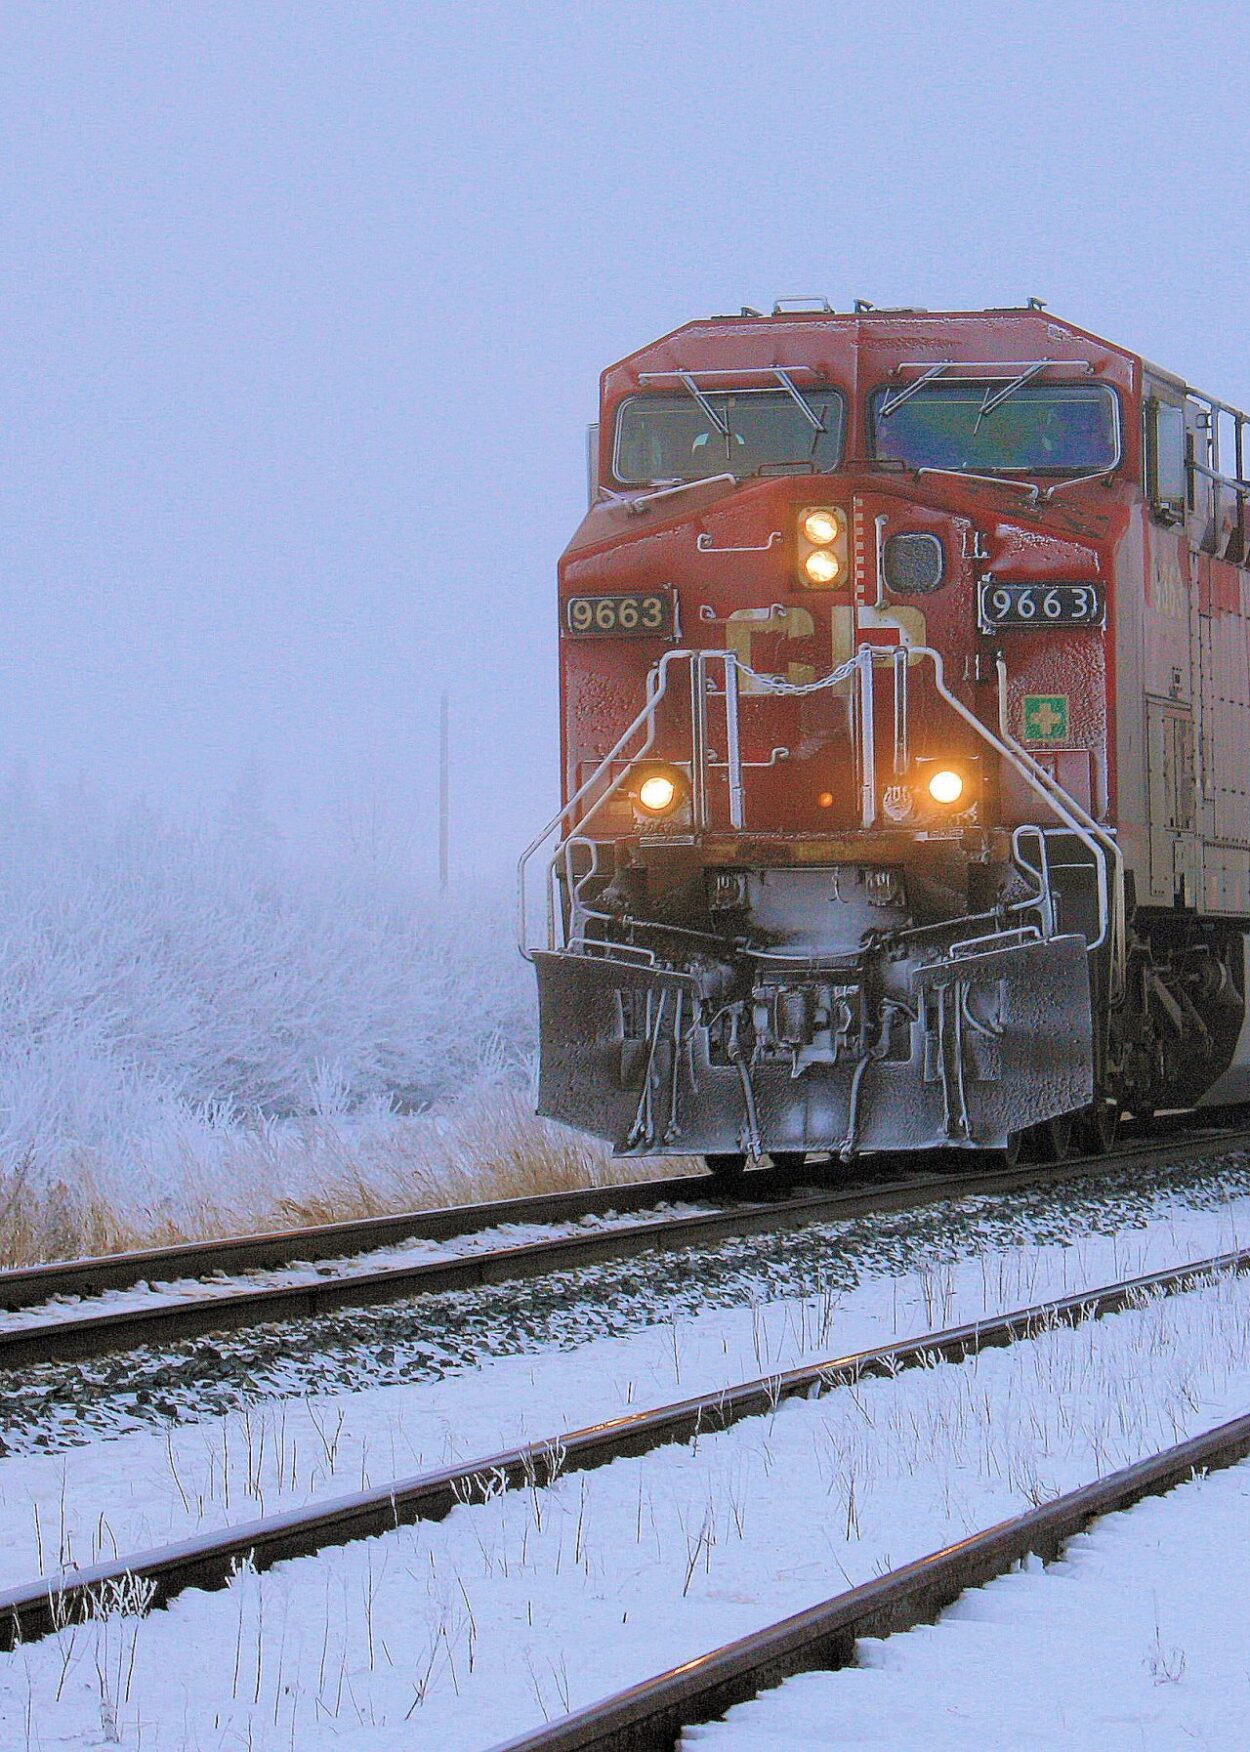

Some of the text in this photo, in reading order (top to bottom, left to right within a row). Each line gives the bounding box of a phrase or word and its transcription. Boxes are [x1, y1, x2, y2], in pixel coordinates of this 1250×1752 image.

[573, 598, 662, 629] 9663
[992, 588, 1088, 618] 9663
[725, 605, 927, 697] CP
